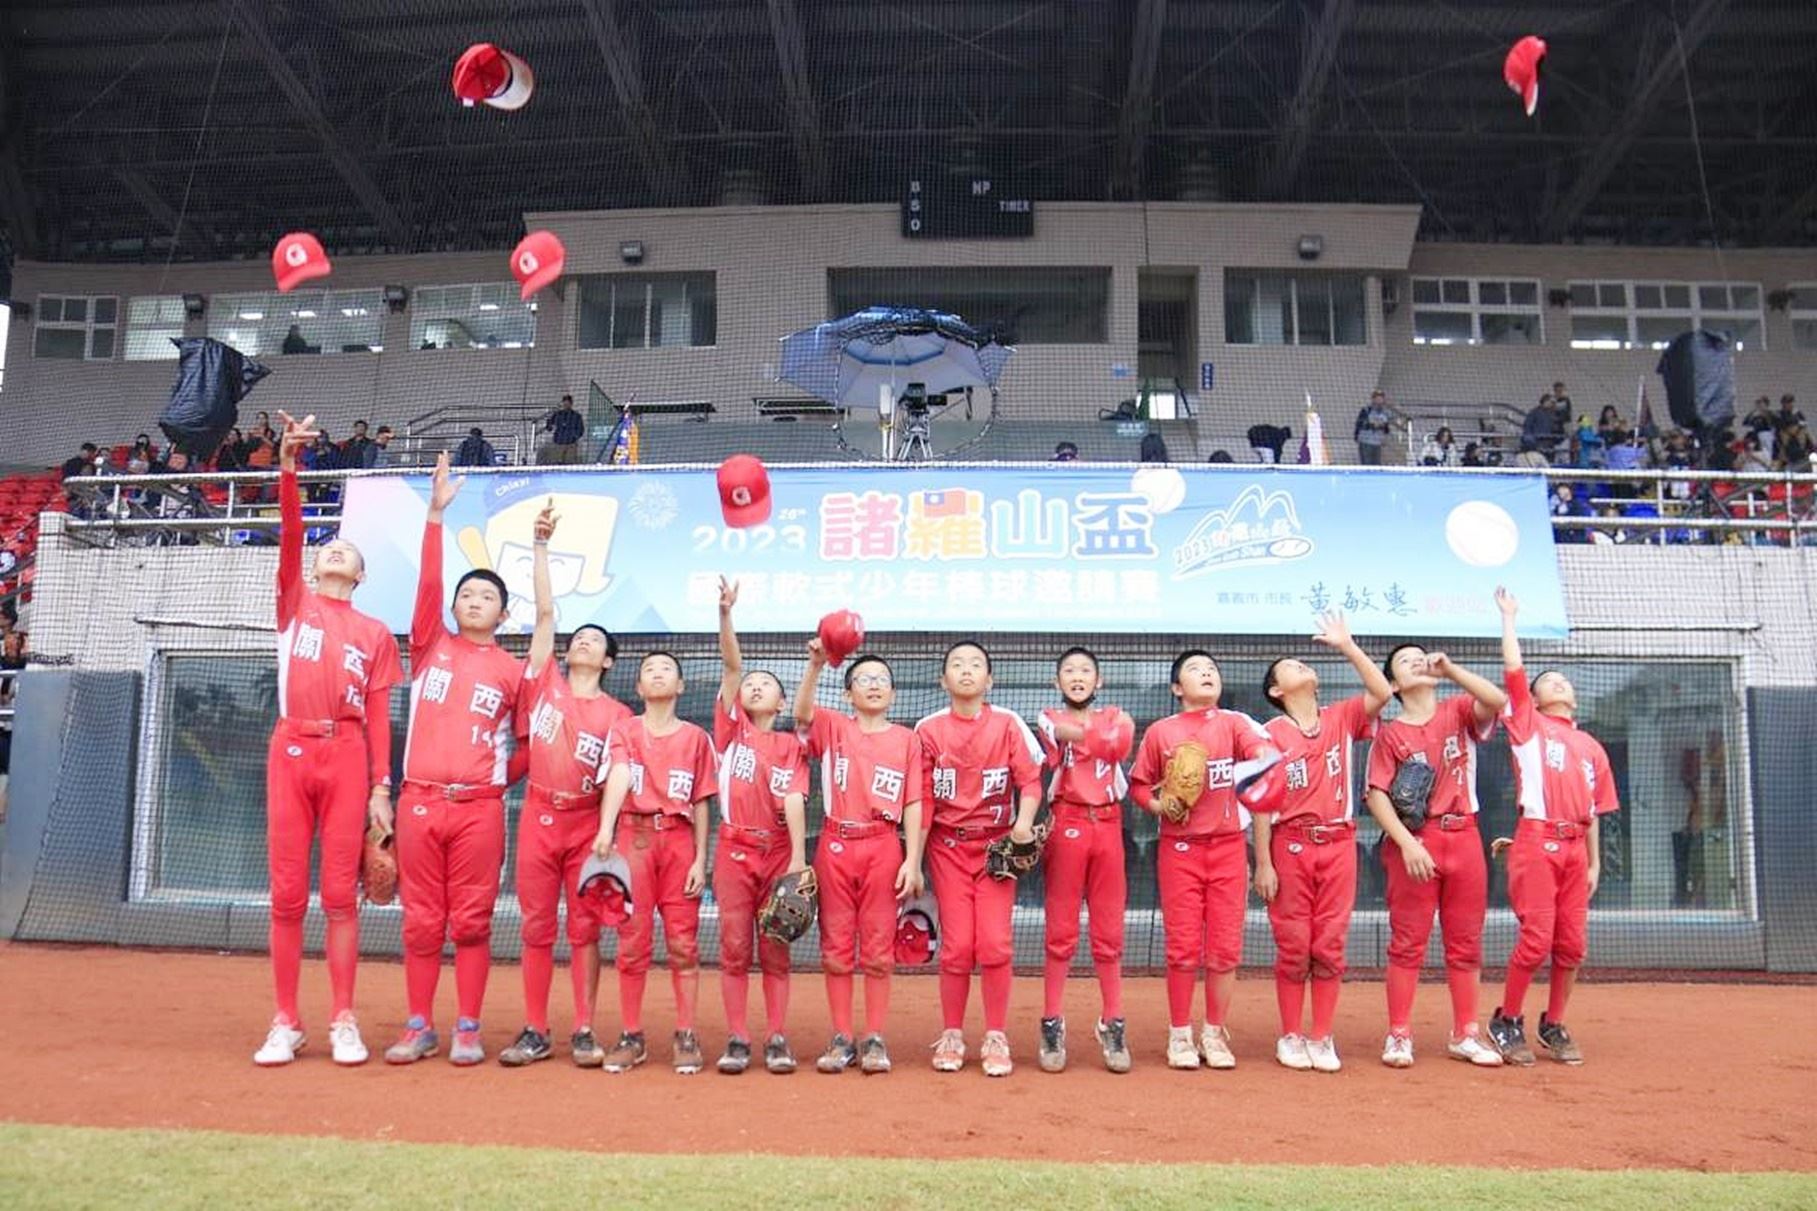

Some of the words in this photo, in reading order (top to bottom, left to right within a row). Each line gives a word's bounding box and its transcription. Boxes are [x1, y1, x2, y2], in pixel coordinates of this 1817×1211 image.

[692, 524, 807, 552] 2023
[819, 490, 1159, 561] 諸羅山盃
